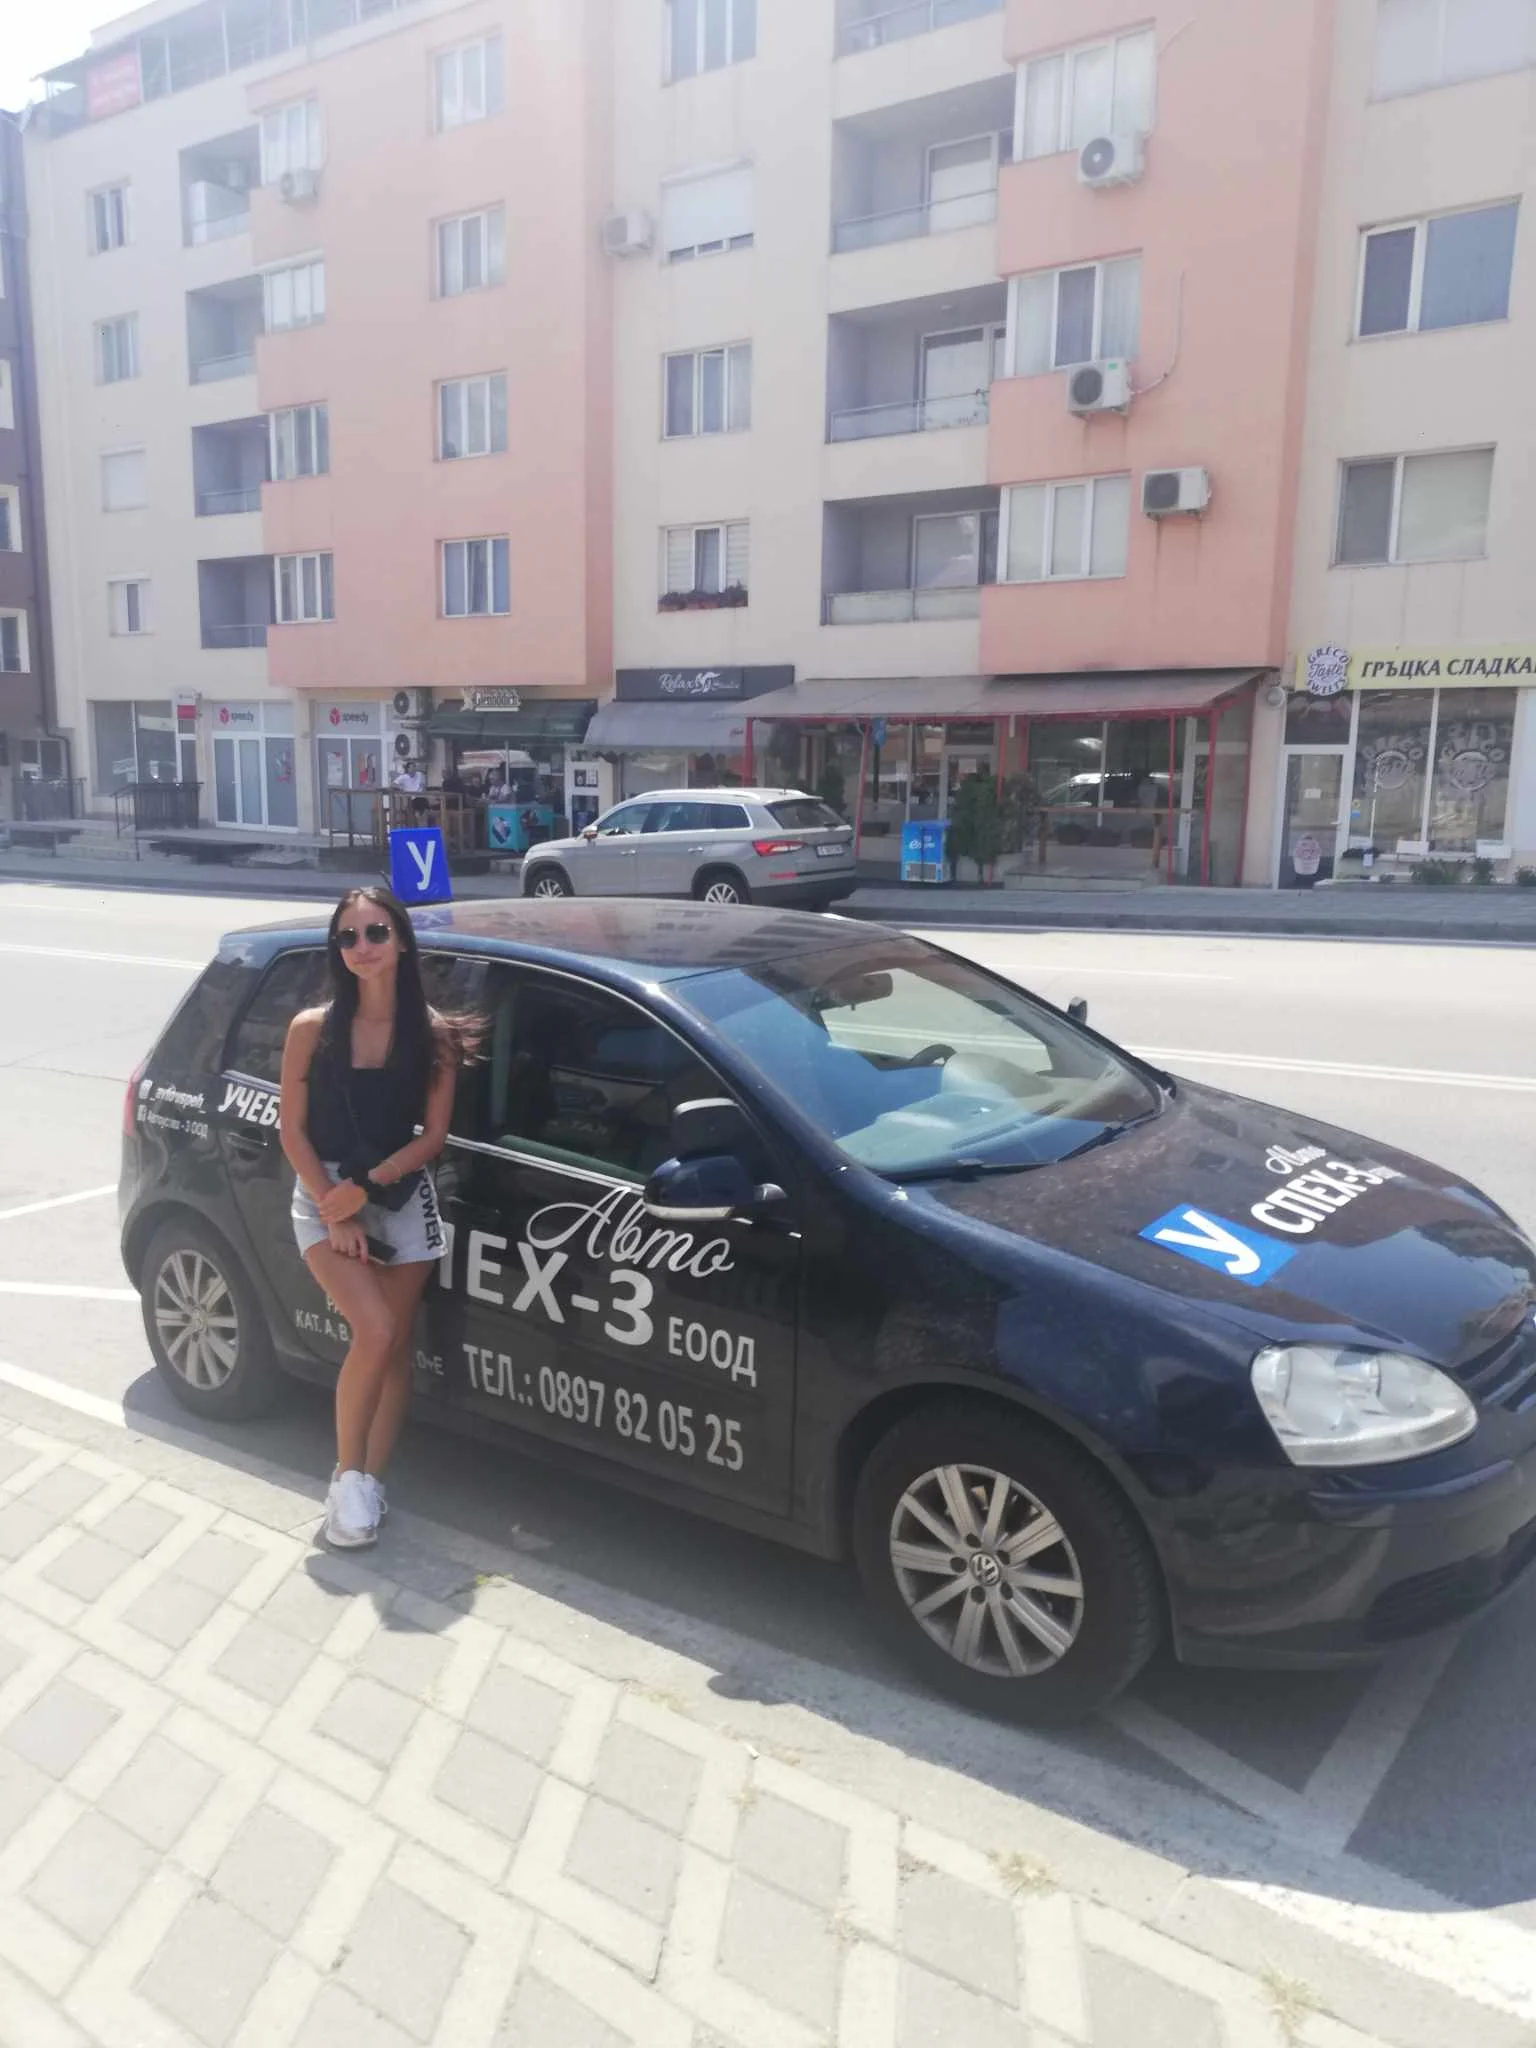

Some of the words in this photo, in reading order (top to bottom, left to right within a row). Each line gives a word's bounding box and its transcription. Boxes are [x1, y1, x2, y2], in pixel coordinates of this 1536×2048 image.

[1361, 659, 1441, 680] ГРЪЦКА
[1446, 656, 1536, 678] СЛАДКА
[217, 1082, 281, 1130] УЧЕБ
[526, 1186, 735, 1278] Авто
[668, 1316, 757, 1388] ЕООД
[539, 1366, 605, 1428] 0897
[614, 1388, 652, 1443] 82
[658, 1400, 697, 1457] 05
[705, 1413, 744, 1472] 25
